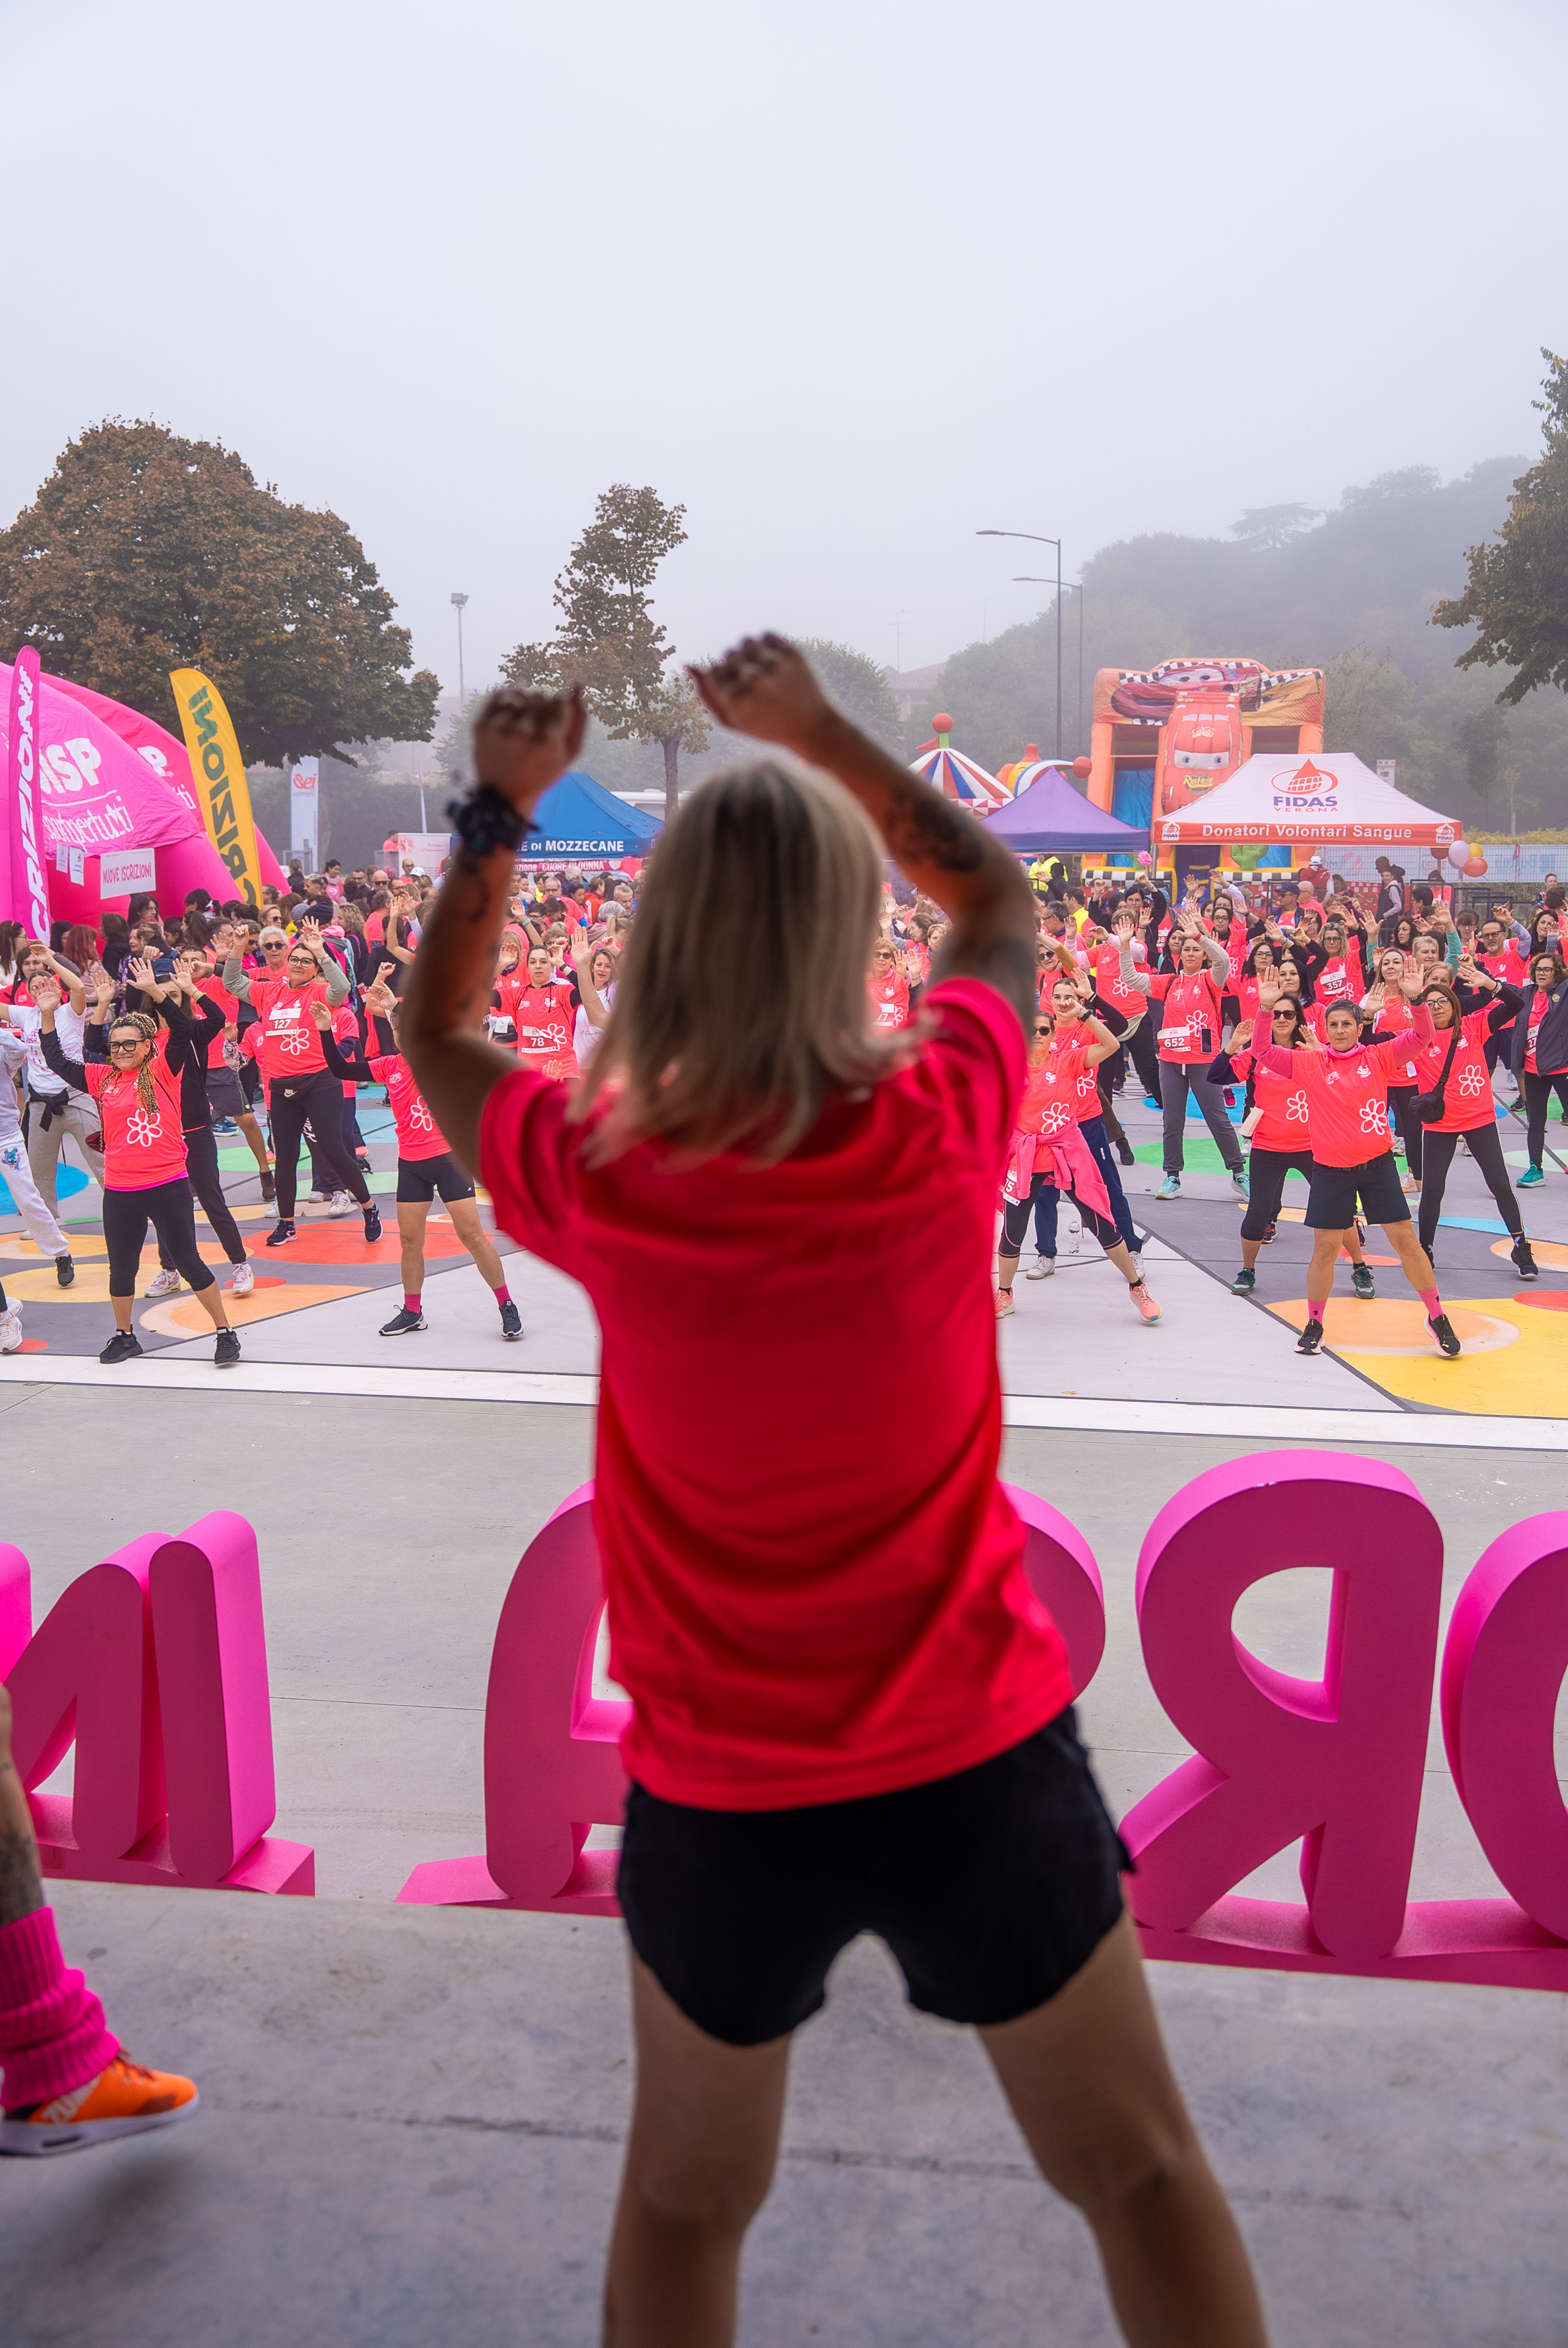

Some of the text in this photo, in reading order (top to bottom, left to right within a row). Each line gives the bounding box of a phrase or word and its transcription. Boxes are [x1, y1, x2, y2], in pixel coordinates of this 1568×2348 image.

[39, 737, 102, 794] ISP
[1273, 796, 1338, 807] FIDAS
[1202, 824, 1412, 841] Donatori Volontari Sangue
[546, 840, 624, 852] MOZZECANE
[102, 866, 120, 885] NUOVE
[121, 862, 153, 883] ISCRIZIONI
[1326, 979, 1343, 991] 357
[273, 1019, 292, 1029] 127
[530, 1037, 545, 1047] 78
[1164, 1037, 1185, 1048] 652
